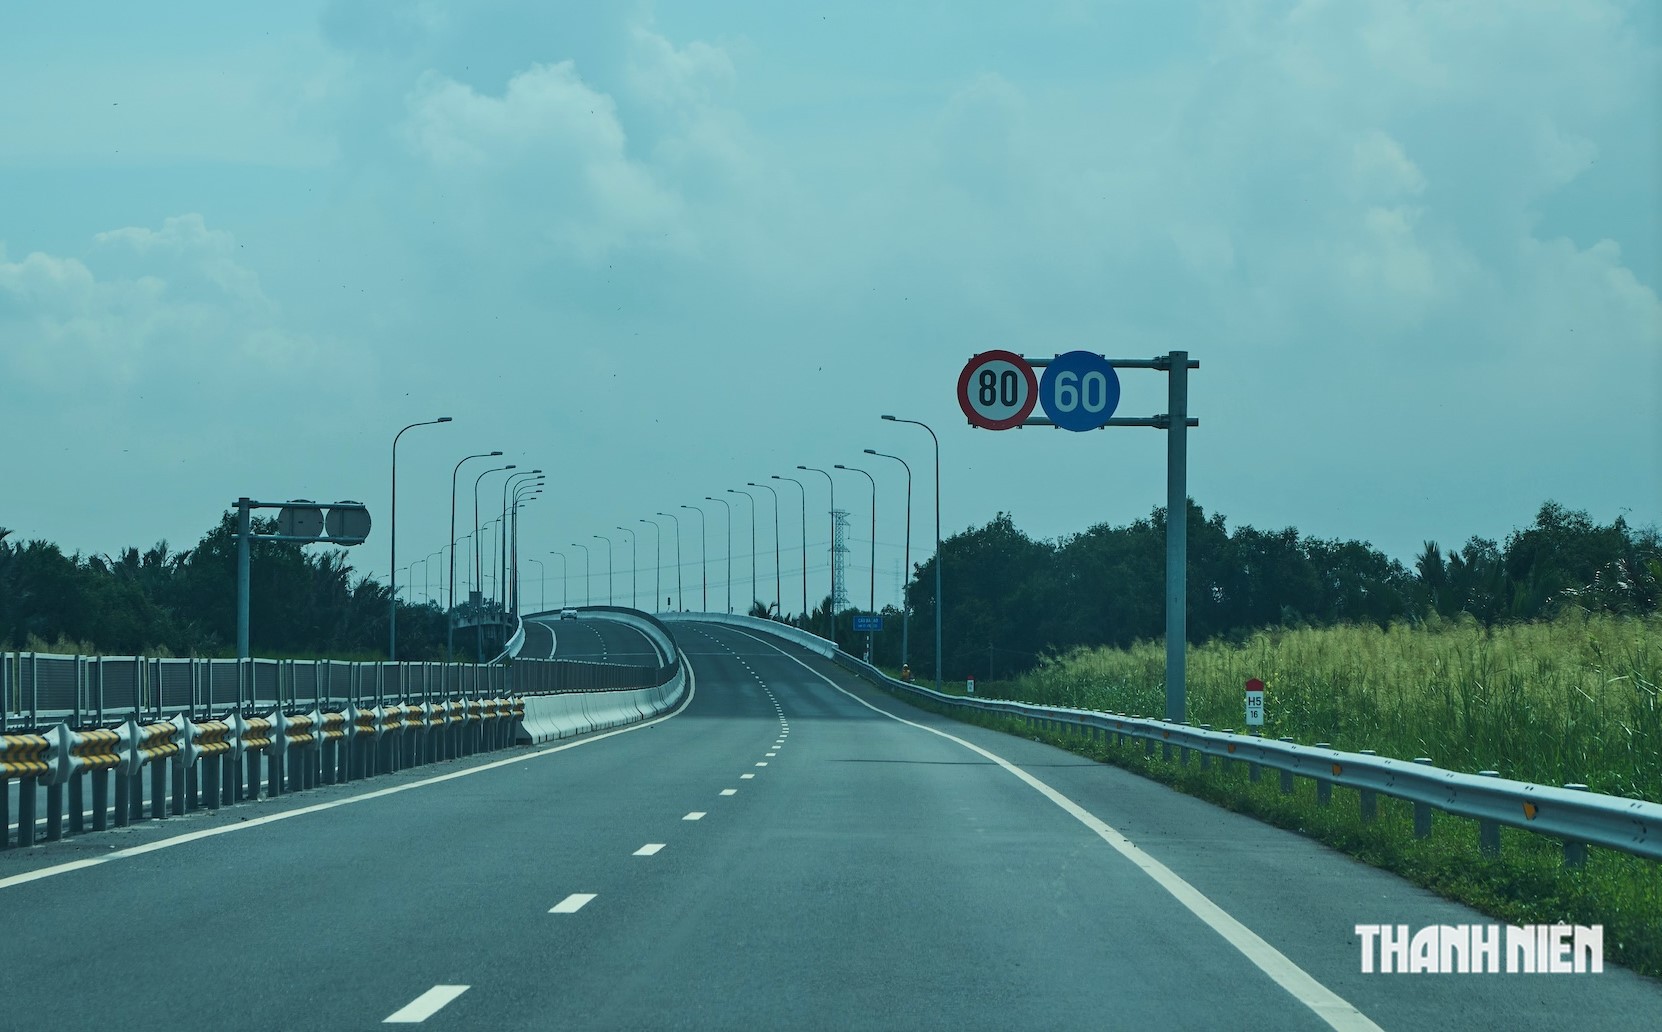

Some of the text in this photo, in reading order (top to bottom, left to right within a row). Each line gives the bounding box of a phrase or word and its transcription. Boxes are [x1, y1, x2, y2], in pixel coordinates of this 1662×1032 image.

[979, 369, 1018, 407] 80
[1054, 370, 1107, 413] 60
[1248, 696, 1262, 706] H5
[1250, 710, 1259, 719] 16
